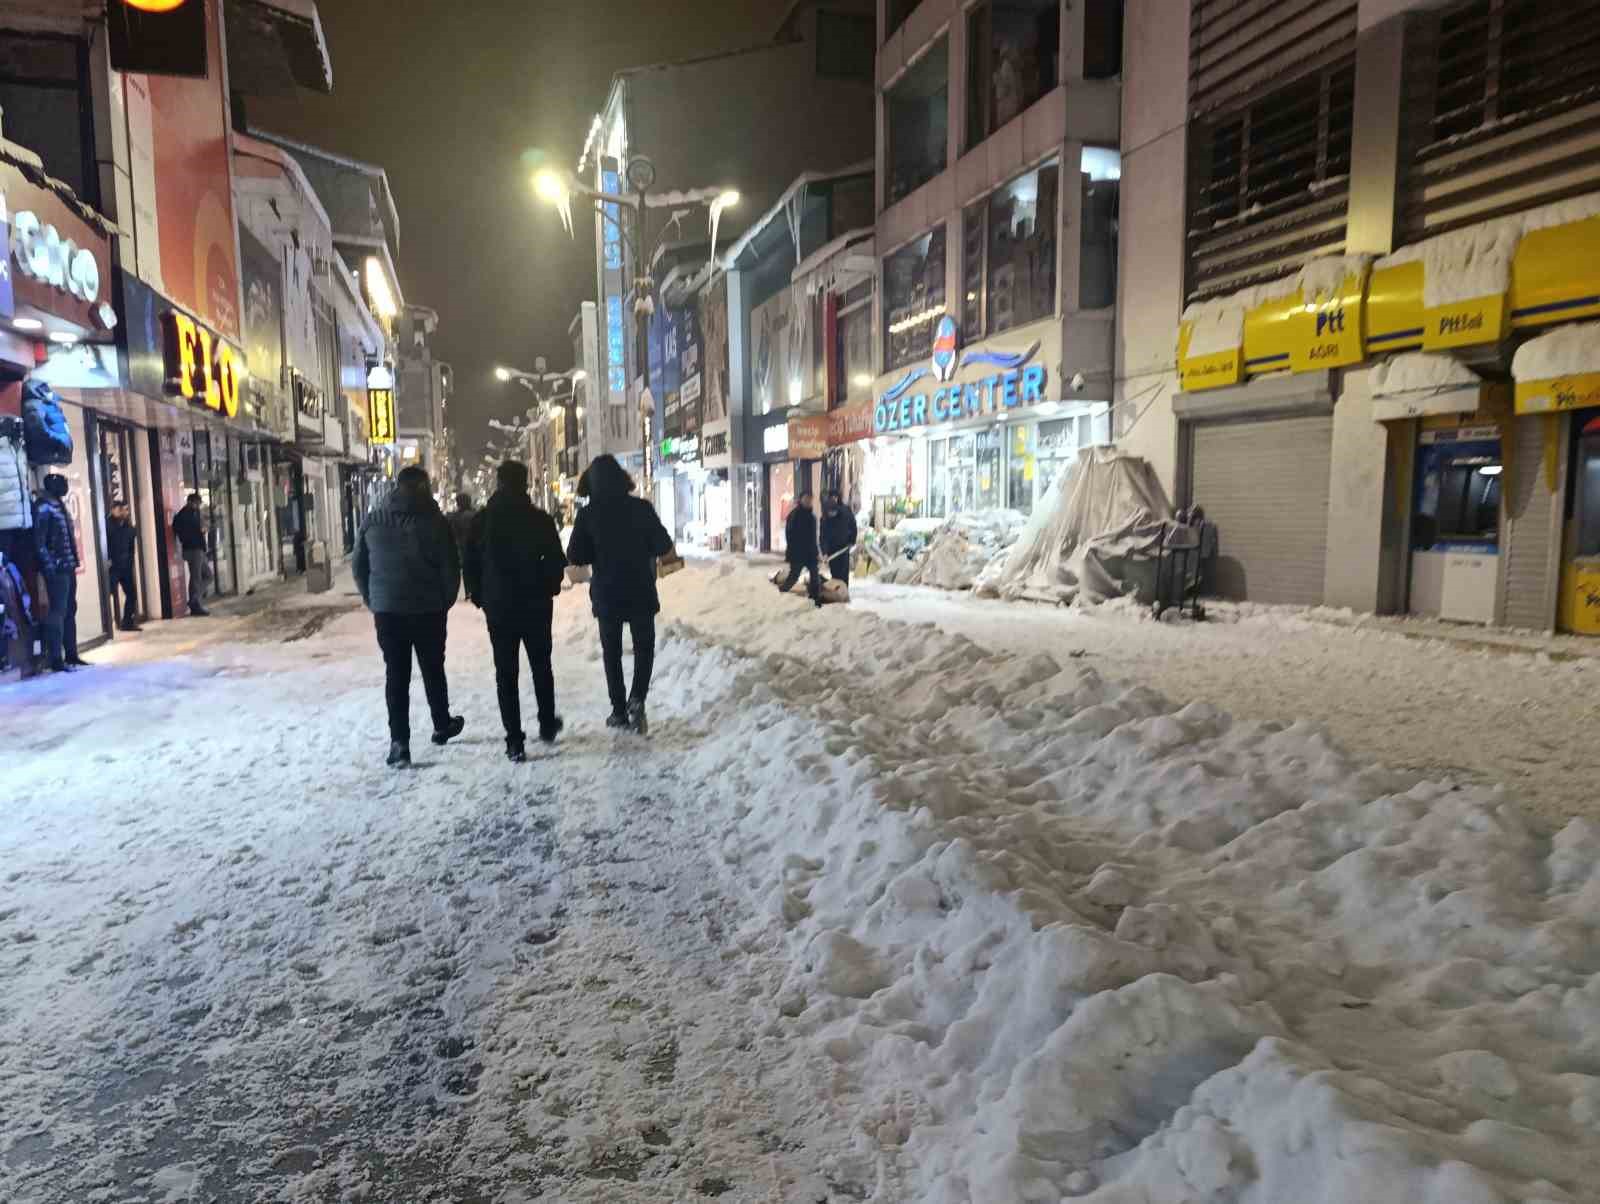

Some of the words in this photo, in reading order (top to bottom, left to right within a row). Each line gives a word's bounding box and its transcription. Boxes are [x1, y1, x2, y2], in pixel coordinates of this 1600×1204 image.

[1316, 308, 1346, 337] Ptt
[176, 313, 239, 417] FLO
[932, 364, 1045, 420] CENTER
